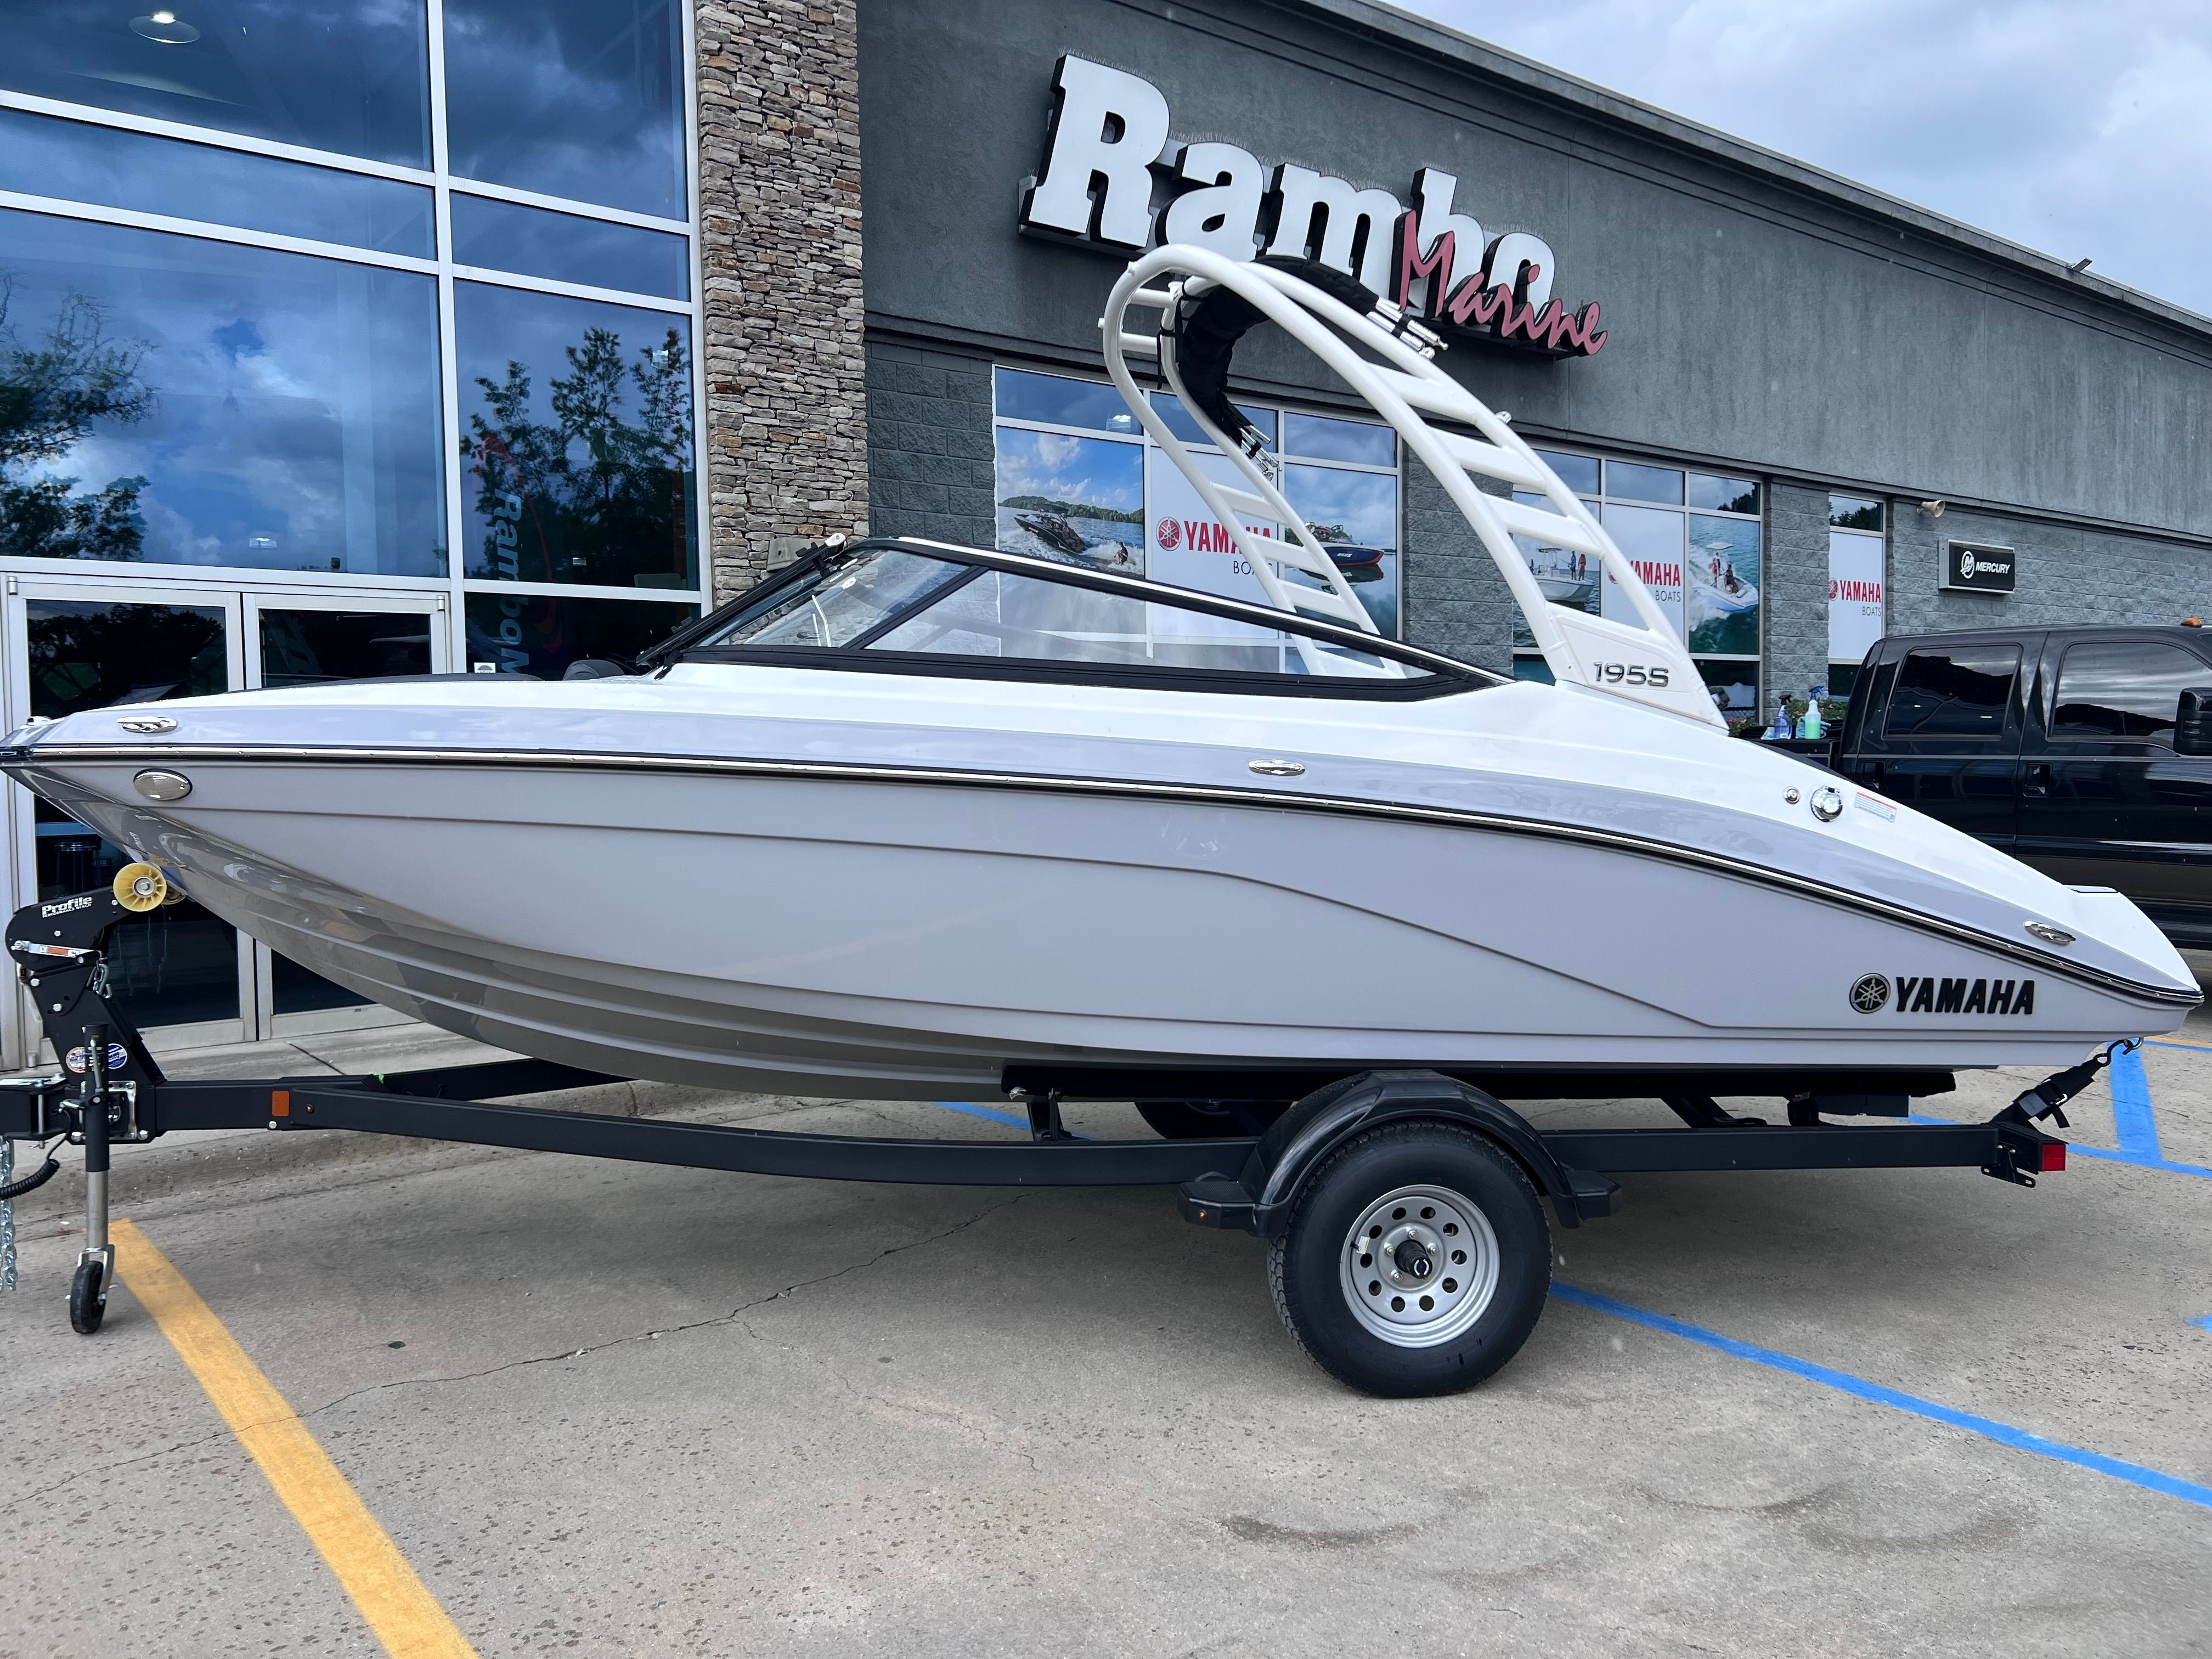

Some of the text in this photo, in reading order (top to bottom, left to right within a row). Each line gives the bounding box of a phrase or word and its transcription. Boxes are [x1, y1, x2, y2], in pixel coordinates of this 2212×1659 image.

[1022, 54, 1556, 307] Rambo
[1396, 210, 1609, 356] Marine
[1630, 560, 1681, 586] AMAHA
[1975, 561, 2011, 574] MERCURY
[1655, 590, 1681, 602] BOATS
[1839, 580, 1881, 603] YAMAHA
[1862, 606, 1881, 617] BOATS
[1593, 662, 1669, 687] 195S
[41, 896, 93, 915] Profile
[1896, 977, 2034, 1014] YAMAHA
